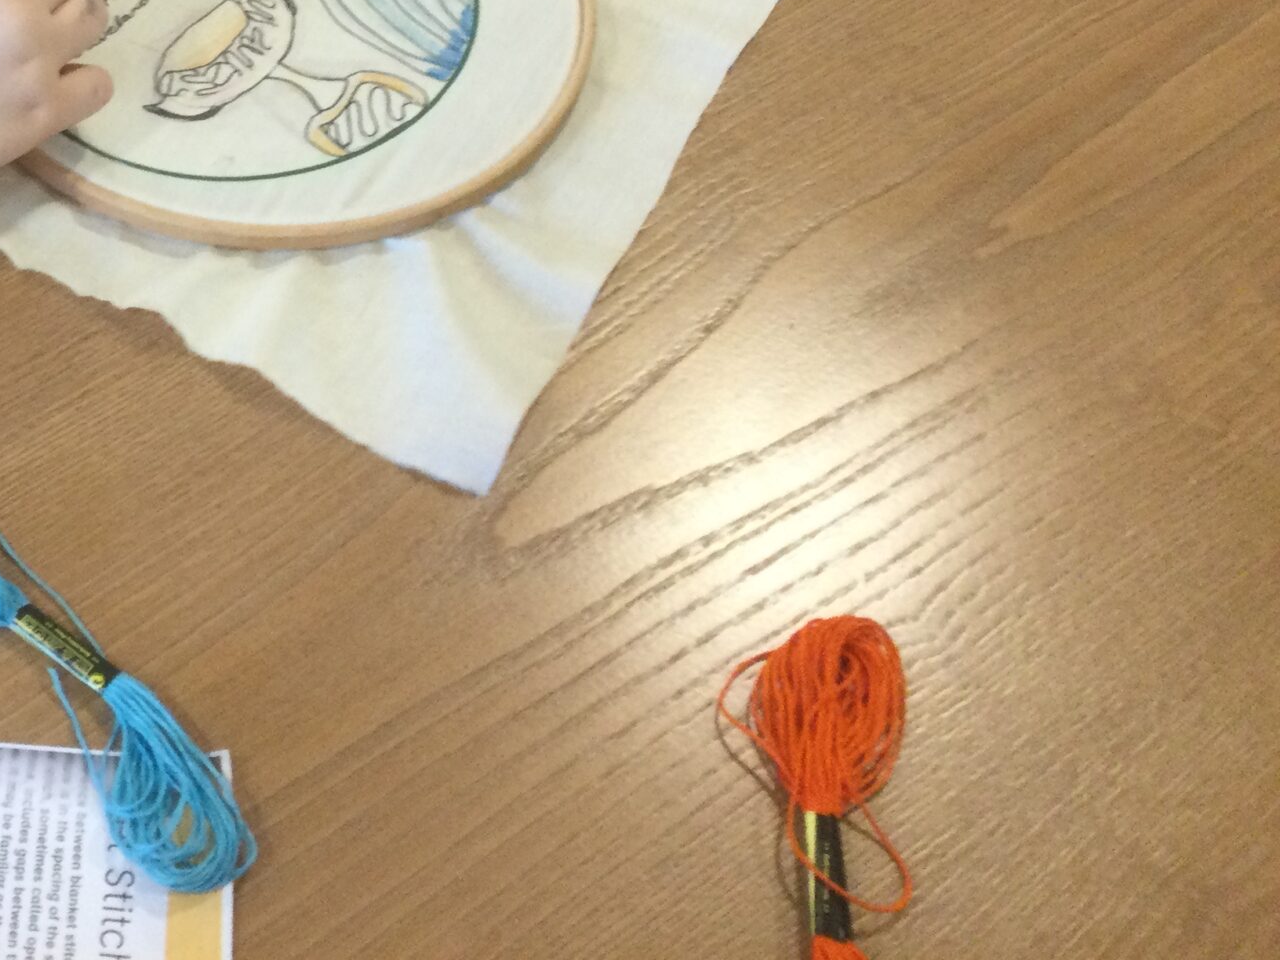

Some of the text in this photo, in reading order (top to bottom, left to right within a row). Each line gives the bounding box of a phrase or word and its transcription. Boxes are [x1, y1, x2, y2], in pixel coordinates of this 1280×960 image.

[33, 809, 48, 881] sometimes
[55, 820, 67, 842] the
[13, 848, 26, 881] gaps
[46, 847, 63, 901] spacing
[8, 886, 24, 947] between
[27, 887, 41, 931] called
[48, 905, 59, 921] of
[66, 875, 81, 928] blanket
[45, 925, 58, 949] the
